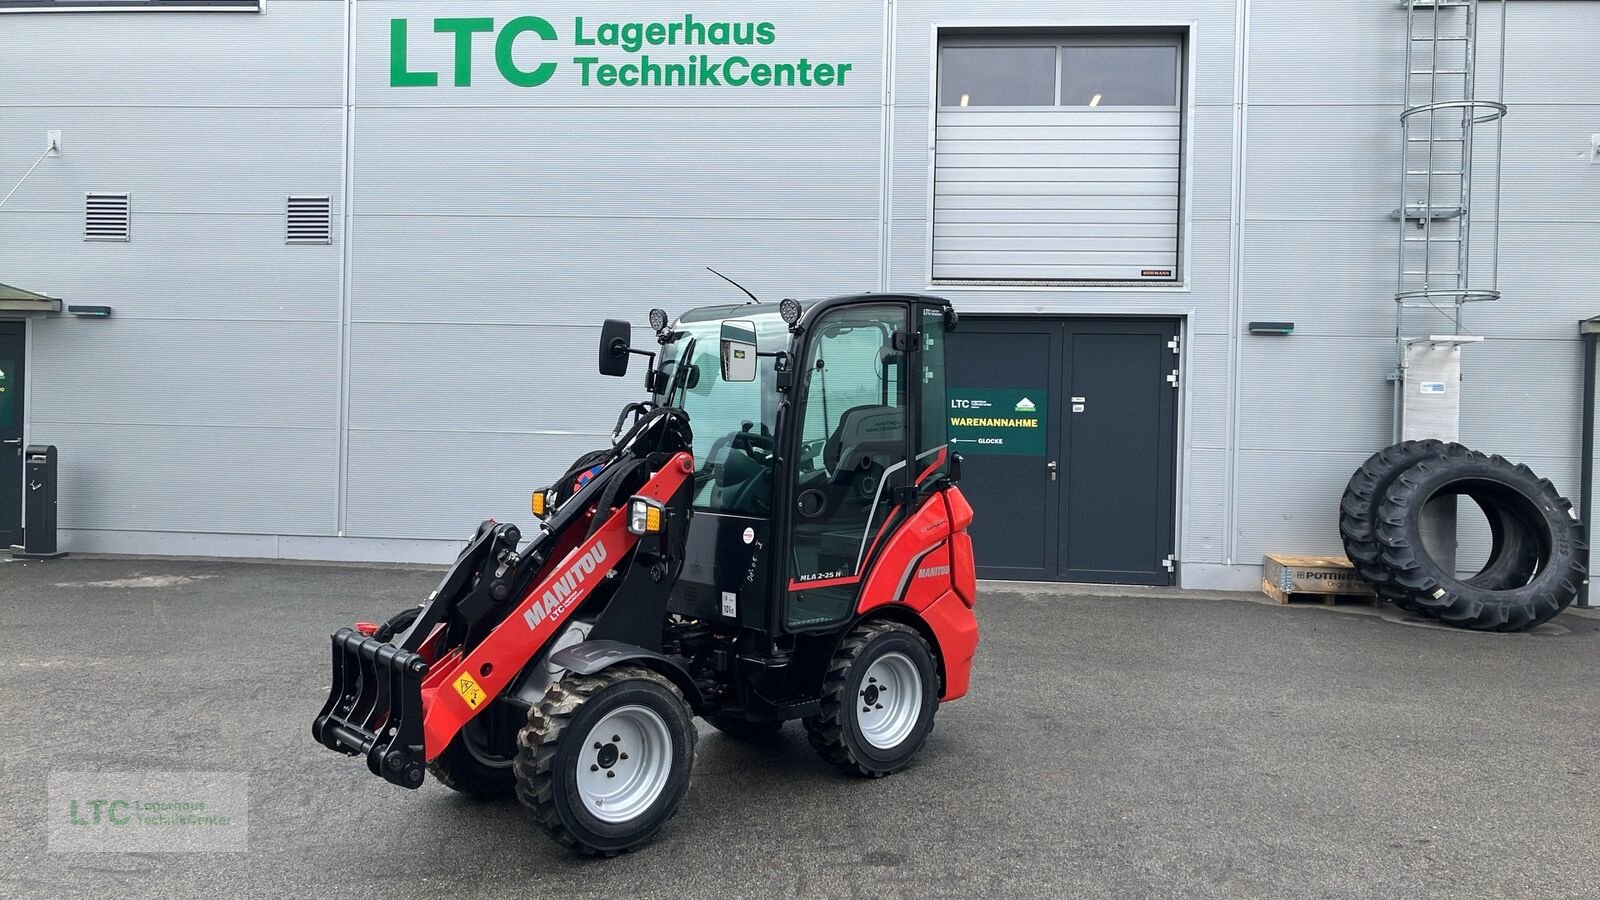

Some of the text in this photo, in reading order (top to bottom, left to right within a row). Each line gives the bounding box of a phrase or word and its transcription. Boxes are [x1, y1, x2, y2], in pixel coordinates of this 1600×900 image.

[575, 14, 776, 52] Lagerhaus
[390, 16, 558, 87] LTC
[573, 55, 852, 87] TechnikCenter
[951, 399, 970, 408] LTC
[950, 417, 1038, 428] WARENANNAHME
[800, 573, 816, 581] MLA
[918, 565, 950, 578] MANITOU
[523, 540, 608, 631] MANITOU
[550, 604, 565, 622] LTC
